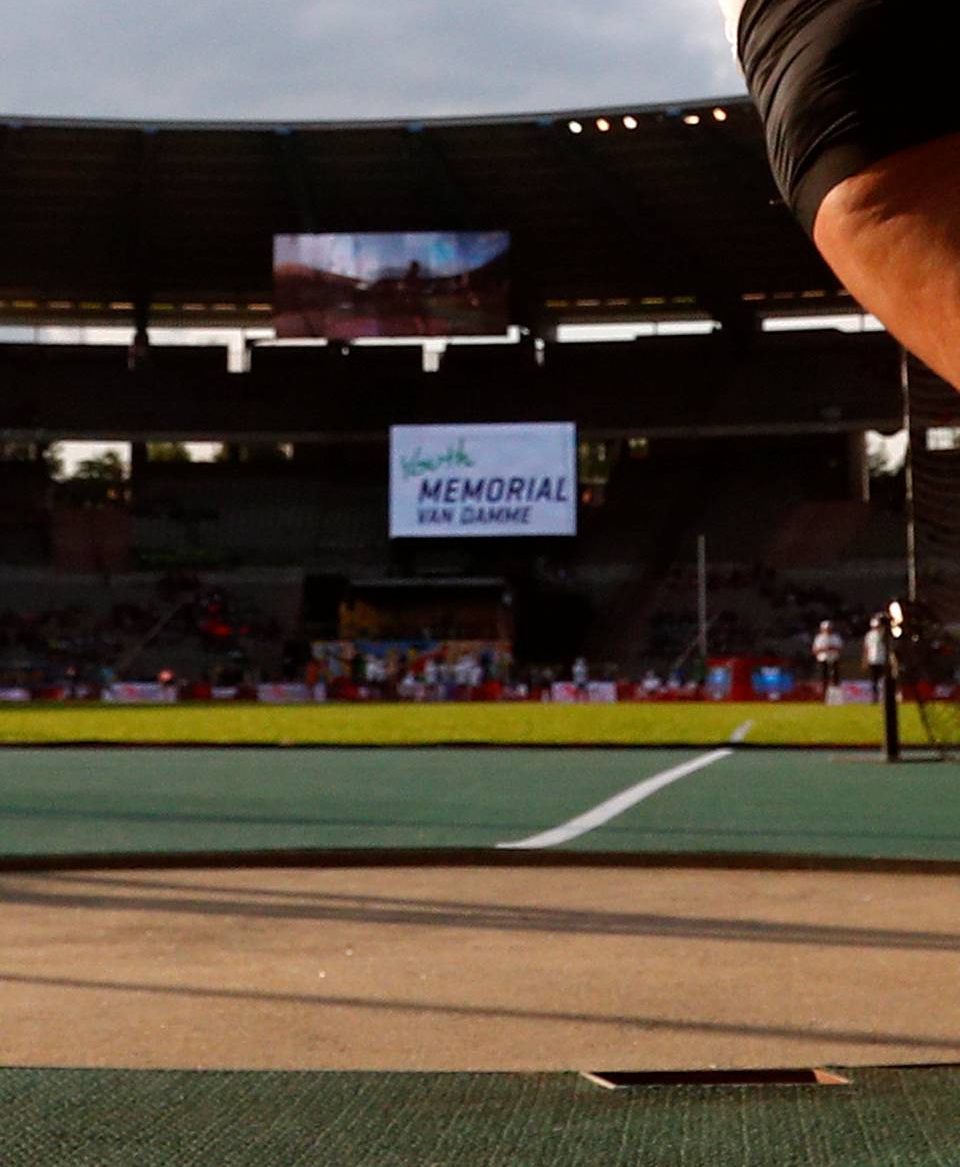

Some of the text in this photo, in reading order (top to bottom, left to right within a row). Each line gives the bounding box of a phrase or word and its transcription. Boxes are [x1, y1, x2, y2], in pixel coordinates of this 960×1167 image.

[419, 476, 567, 503] MEMORIAL
[418, 507, 531, 525] VAN DAMME
